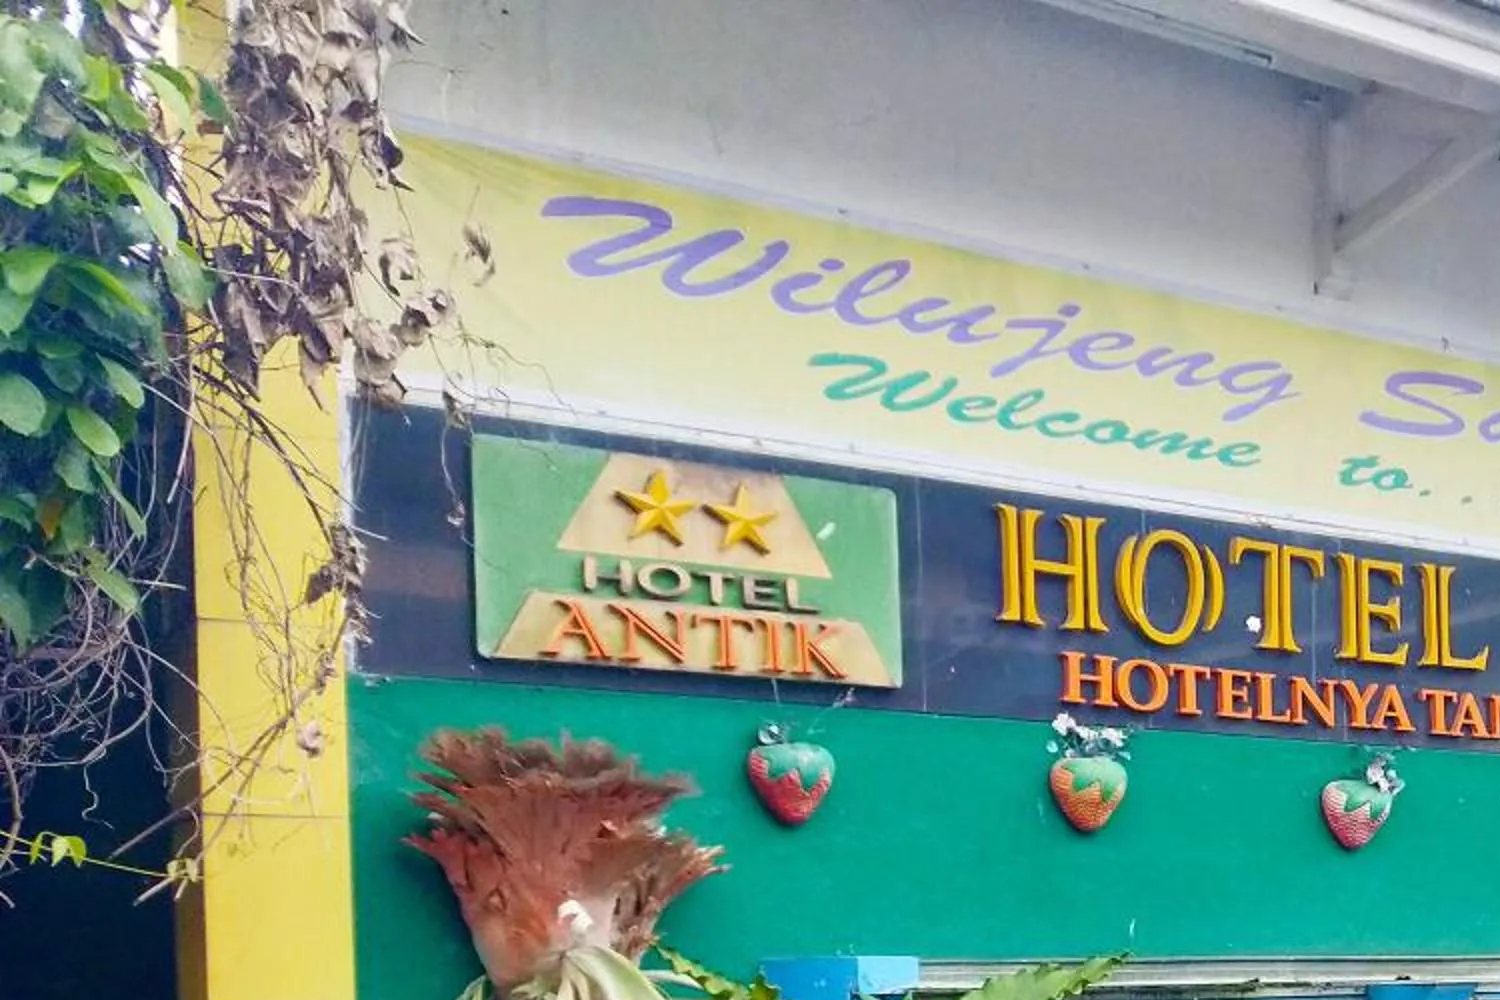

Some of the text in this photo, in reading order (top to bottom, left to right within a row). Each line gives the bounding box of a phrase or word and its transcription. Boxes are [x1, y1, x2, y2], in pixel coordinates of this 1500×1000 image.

[541, 195, 1301, 421] Wilujeng
[809, 352, 1261, 467] Welcome
[582, 556, 820, 613] HOTEL
[995, 504, 1489, 673] HOTEL
[540, 599, 847, 678] ANTIK
[1058, 651, 1414, 733] HOTELNYA
